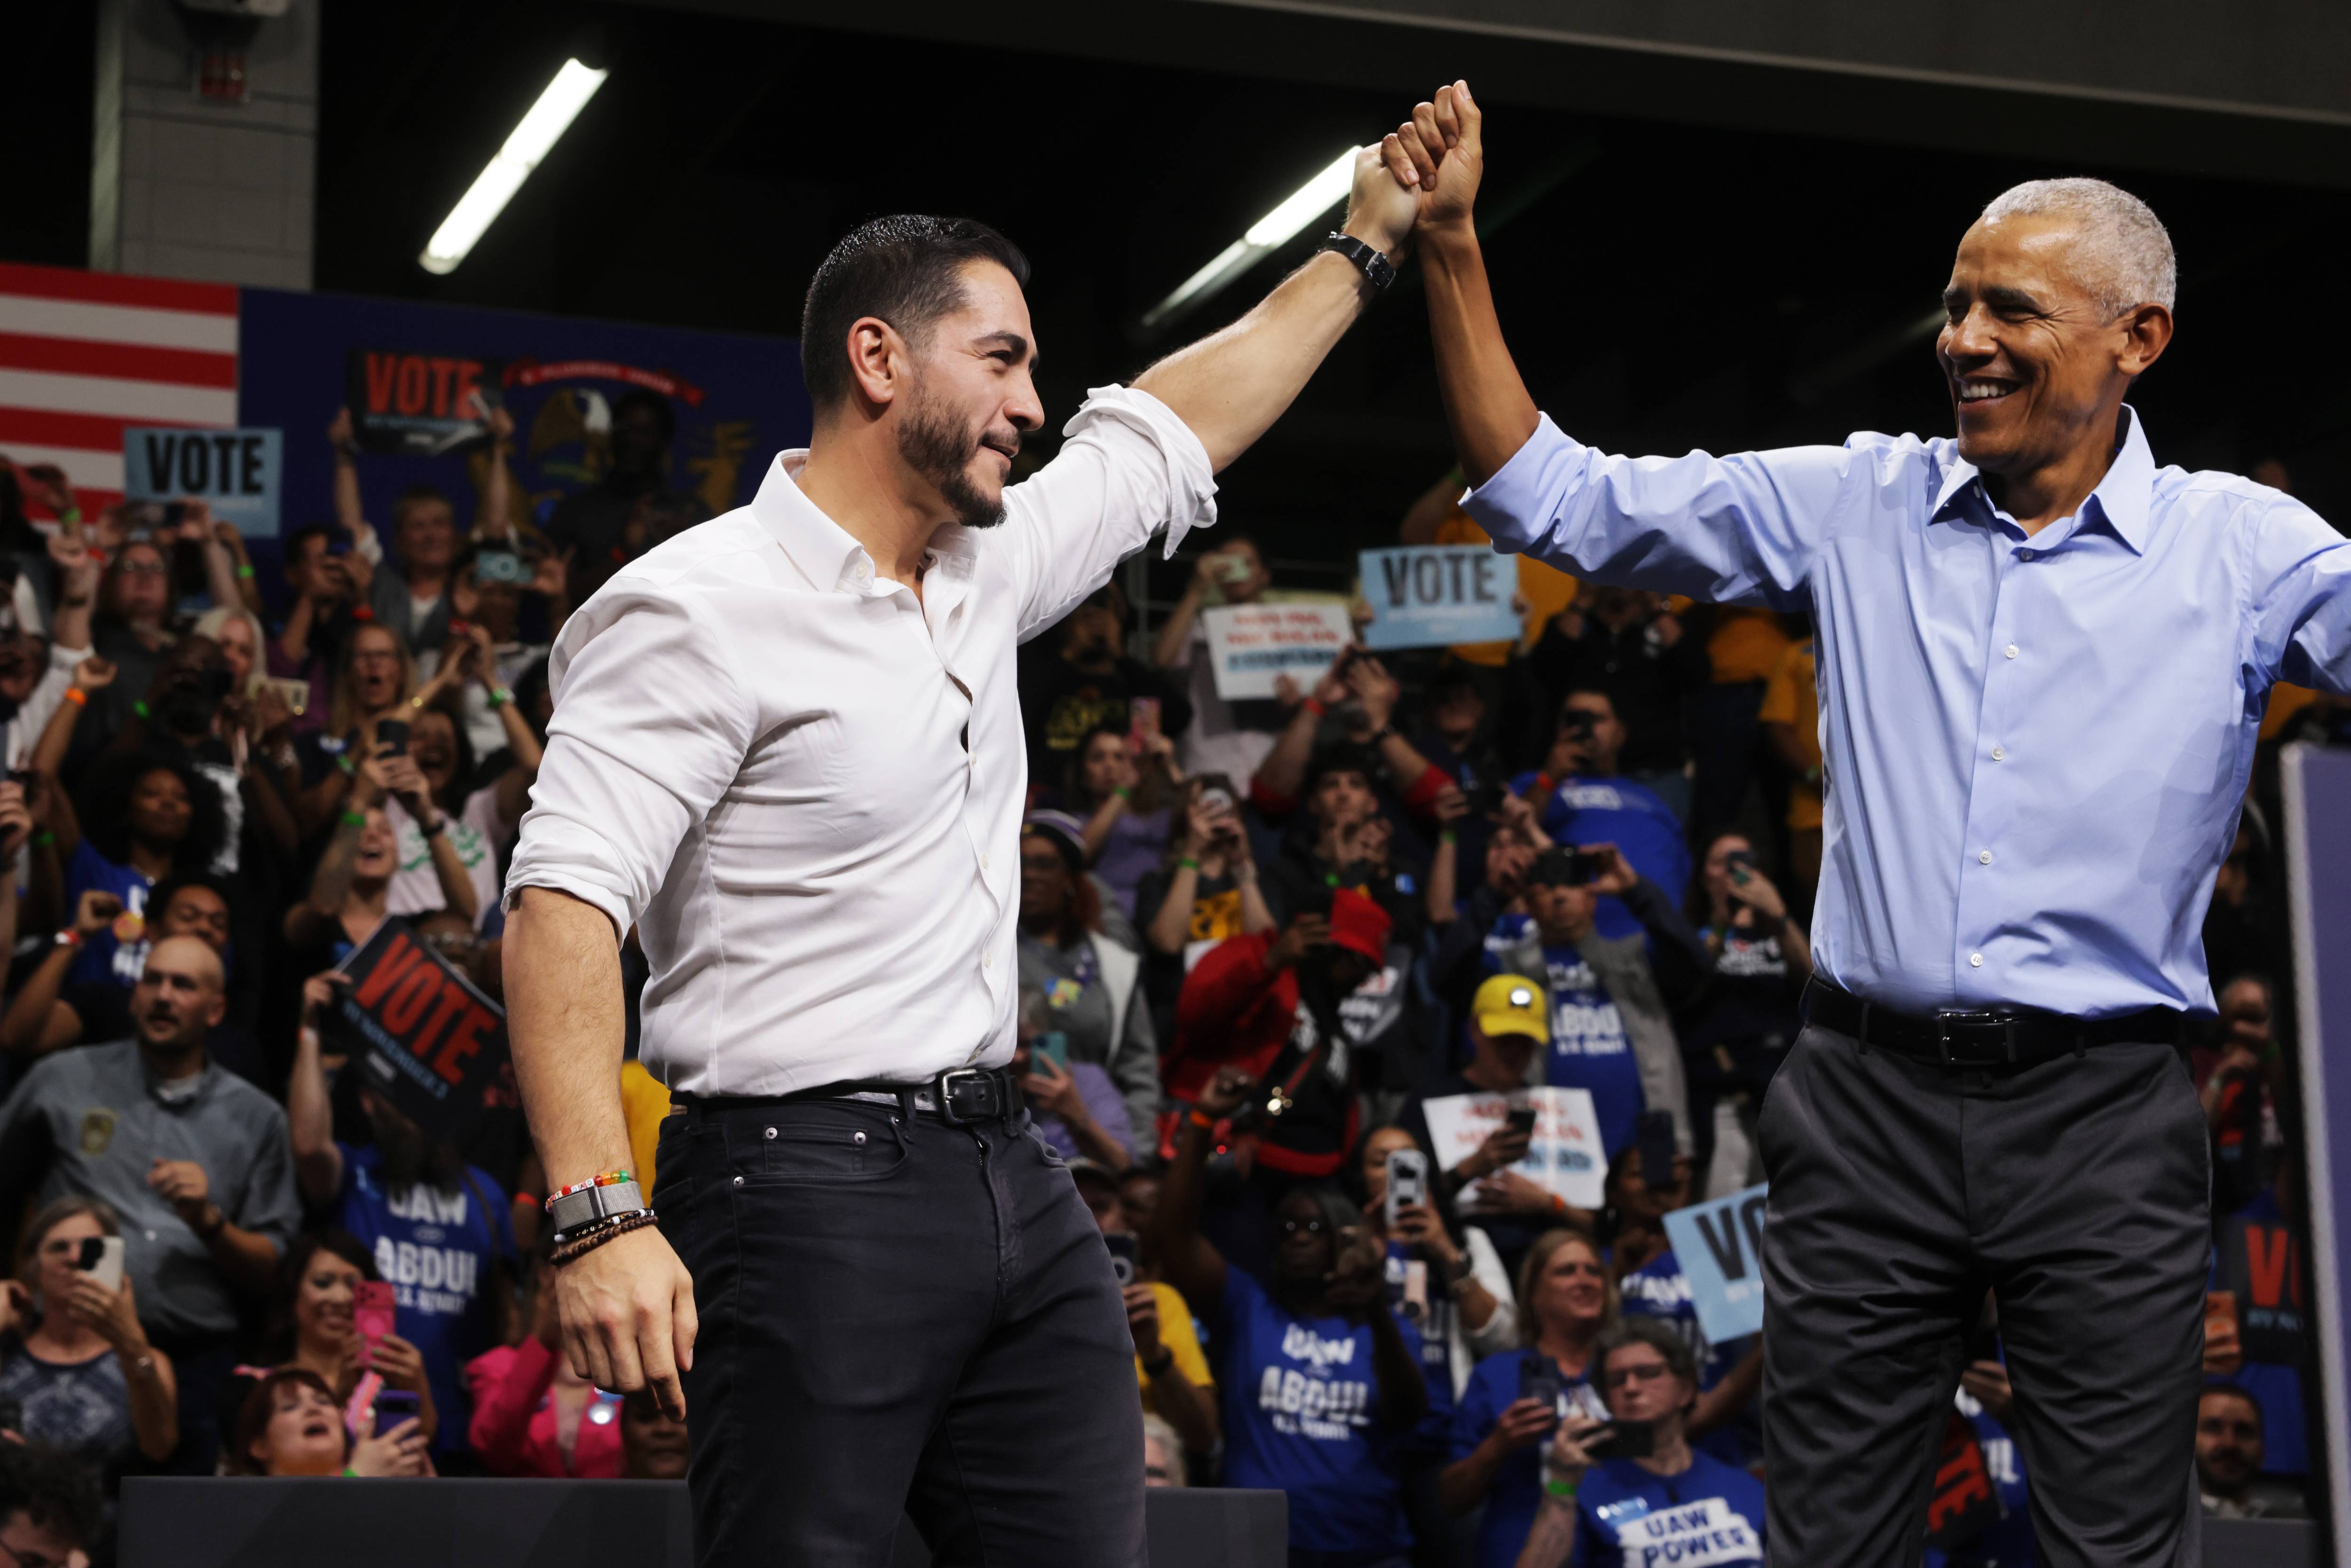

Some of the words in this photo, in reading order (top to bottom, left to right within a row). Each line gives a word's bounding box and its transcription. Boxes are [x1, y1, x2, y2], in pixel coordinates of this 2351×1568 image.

[365, 351, 483, 419] VOTE
[146, 435, 263, 495] VOTE
[1382, 552, 1496, 607] VOTE
[353, 931, 497, 1087] VOTE
[1644, 1527, 1745, 1568] POWER
[1646, 1508, 1708, 1537] UAW
